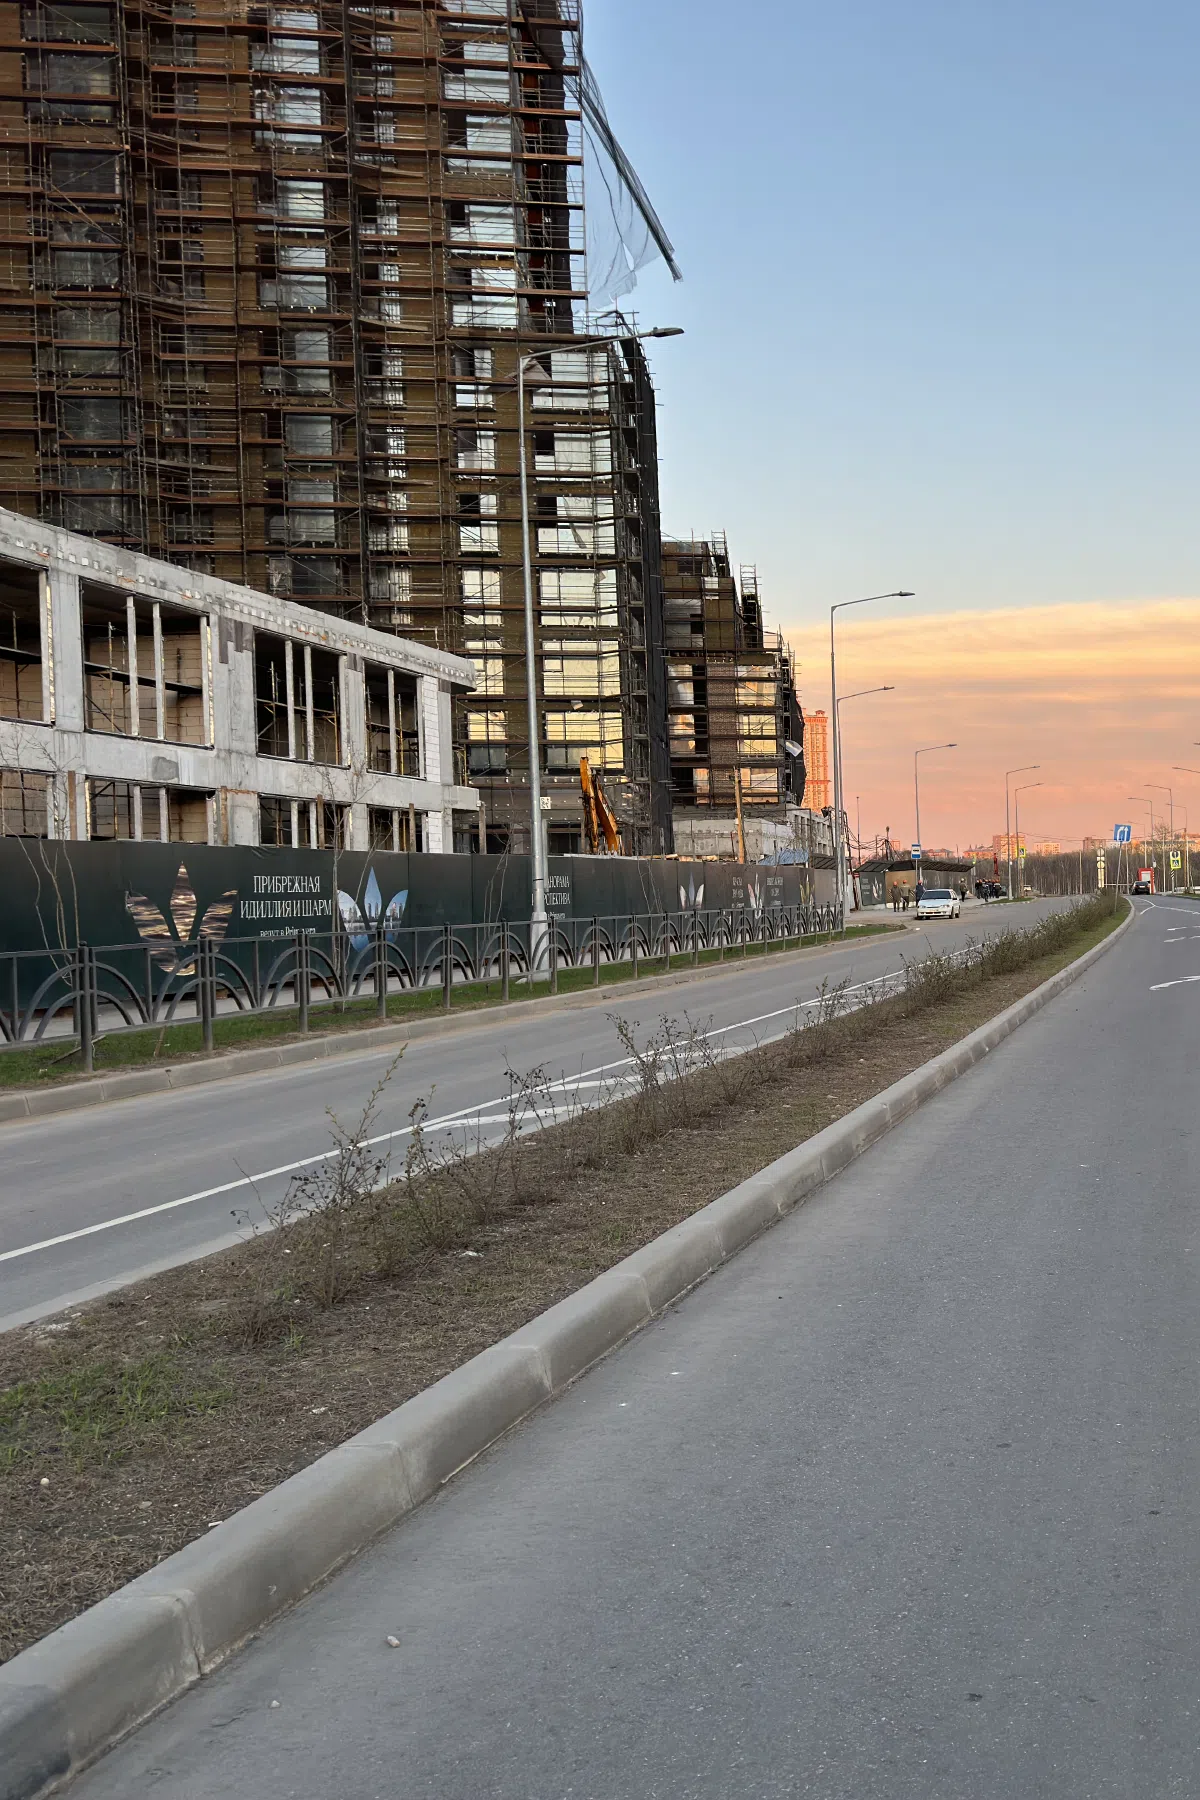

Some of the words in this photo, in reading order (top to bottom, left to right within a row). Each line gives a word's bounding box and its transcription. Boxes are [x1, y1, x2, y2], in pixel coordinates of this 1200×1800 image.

[253, 875, 321, 893] ПРИБРЕЖНАЯ
[240, 900, 292, 919] ИДИЛЛИЯ
[293, 900, 301, 917] И
[302, 899, 332, 917] ШАРМ
